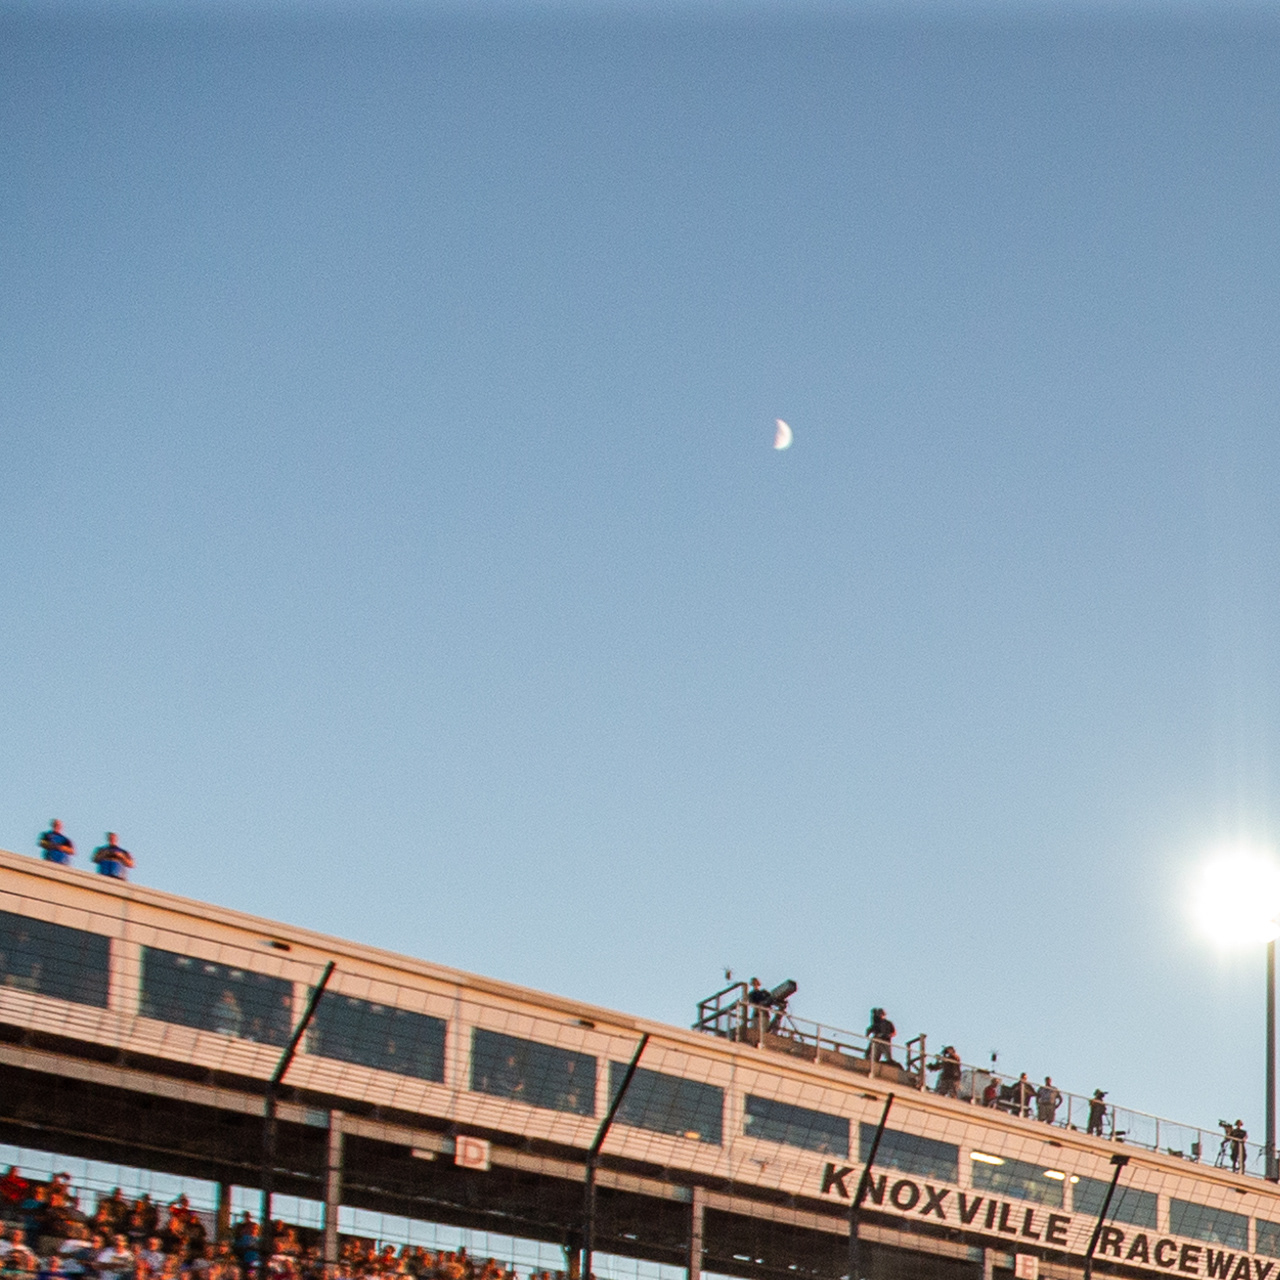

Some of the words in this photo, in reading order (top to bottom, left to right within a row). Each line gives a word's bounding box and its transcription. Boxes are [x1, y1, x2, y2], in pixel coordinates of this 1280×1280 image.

[464, 1140, 485, 1165] D
[820, 1162, 1071, 1246] KNOXVILLE
[1022, 1256, 1034, 1278] E
